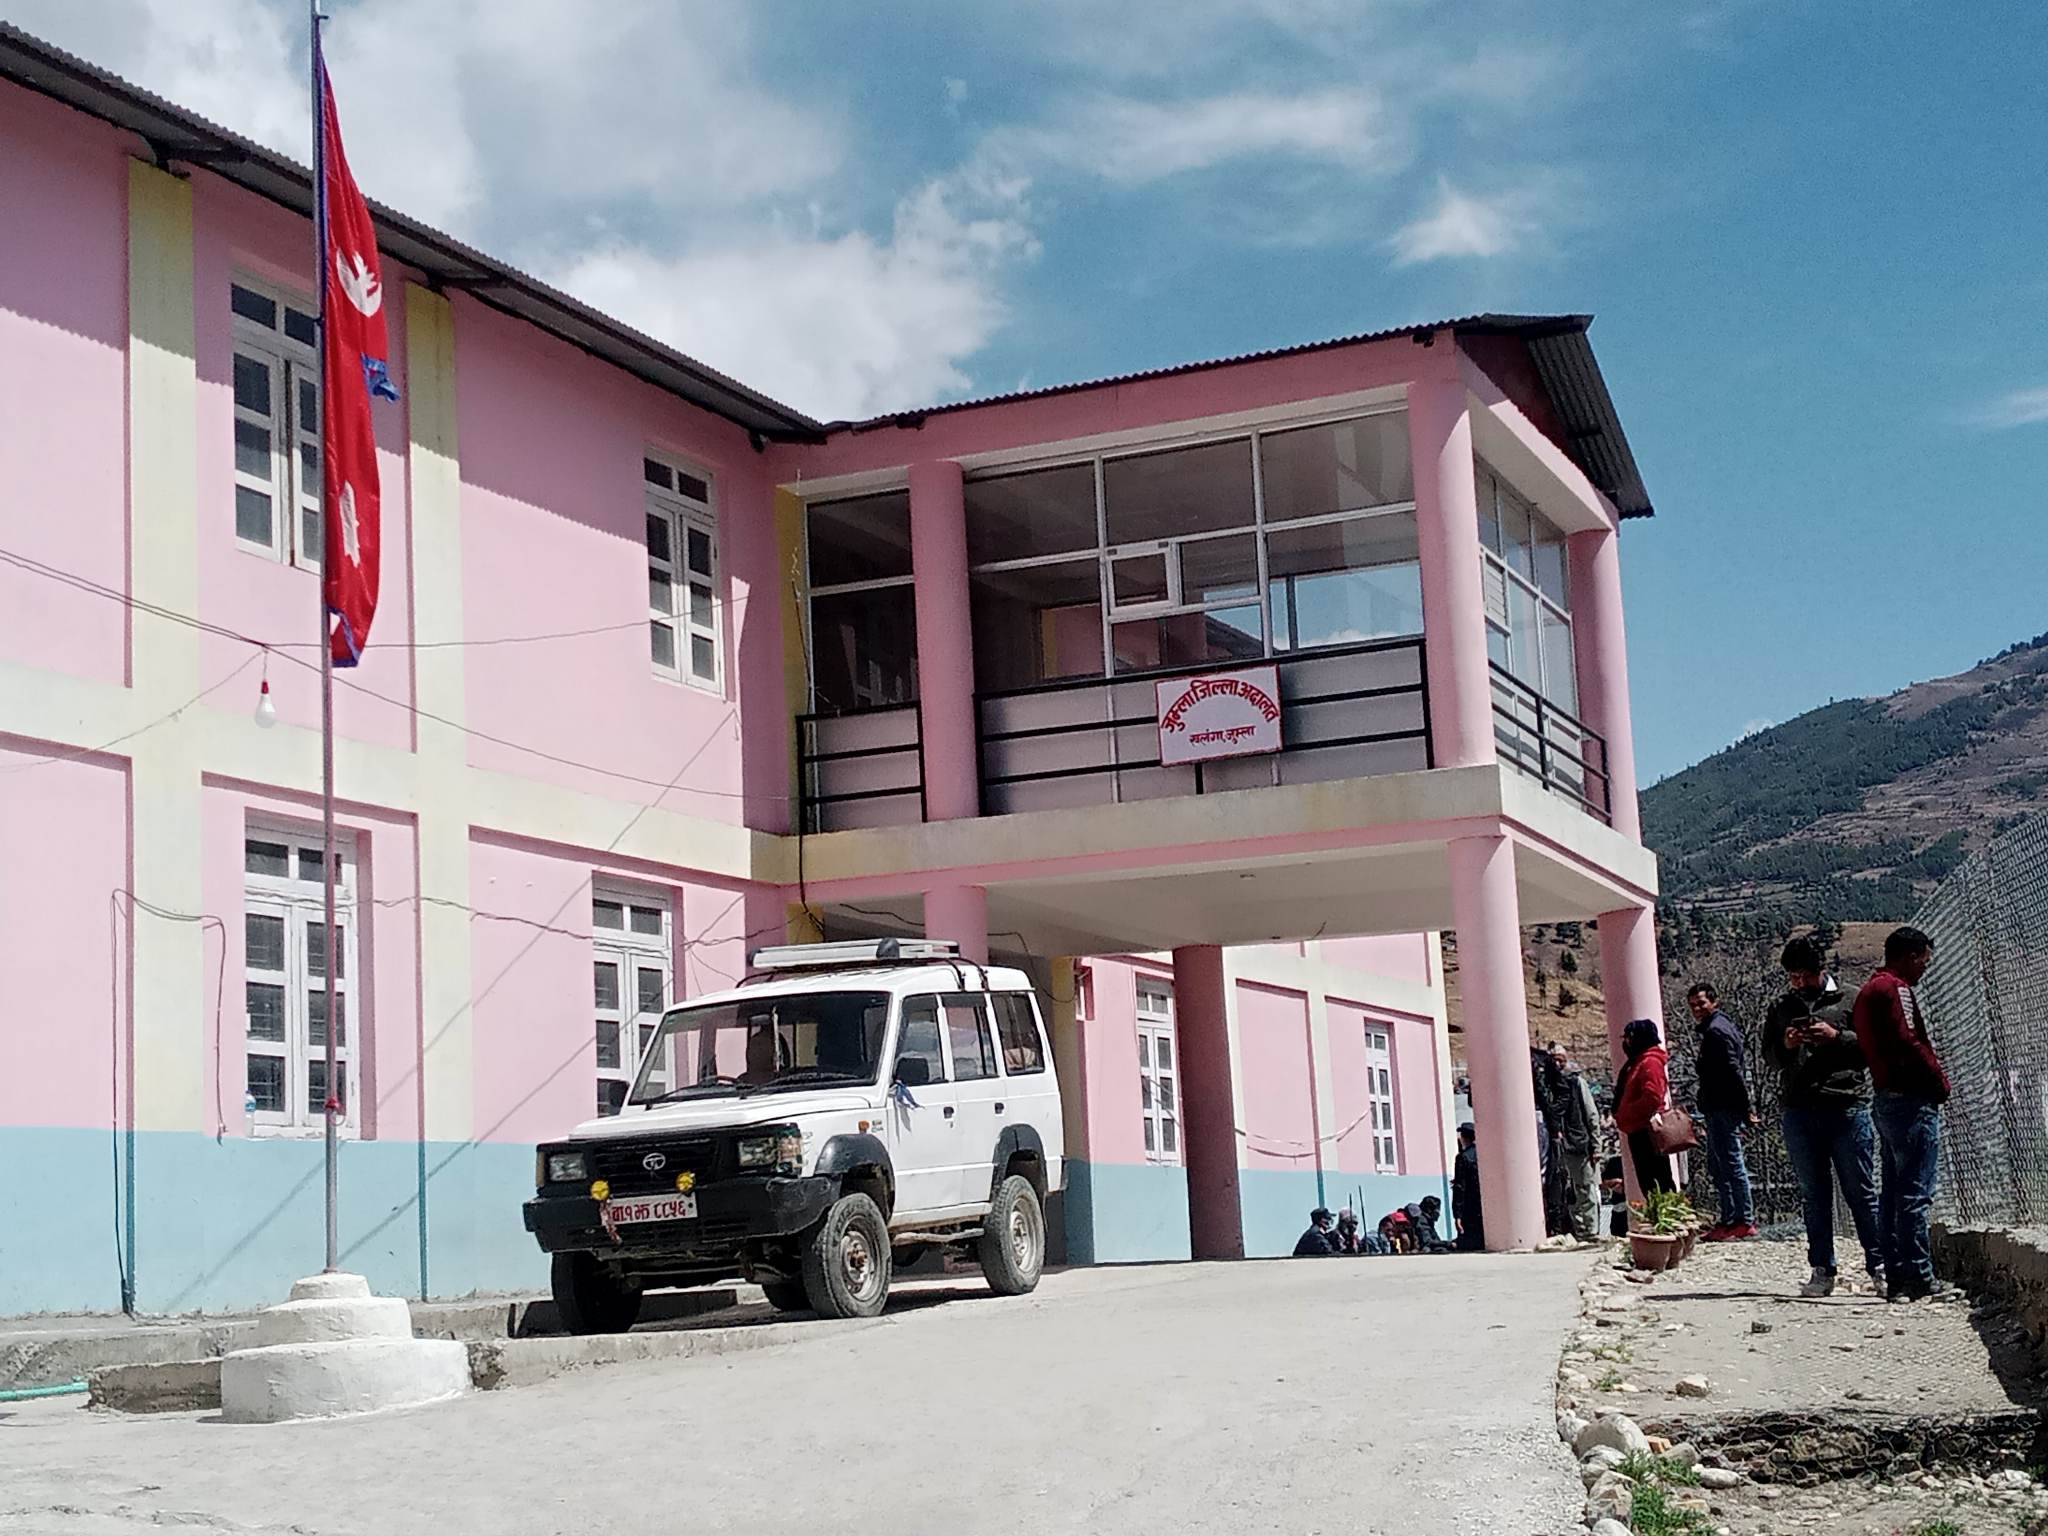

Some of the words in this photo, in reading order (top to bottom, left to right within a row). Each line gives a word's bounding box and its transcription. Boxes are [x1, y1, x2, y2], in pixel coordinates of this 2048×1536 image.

[1161, 690, 1197, 733] जुम्ला
[1190, 679, 1239, 702] जिल्ला
[1237, 681, 1279, 722] अदालत
